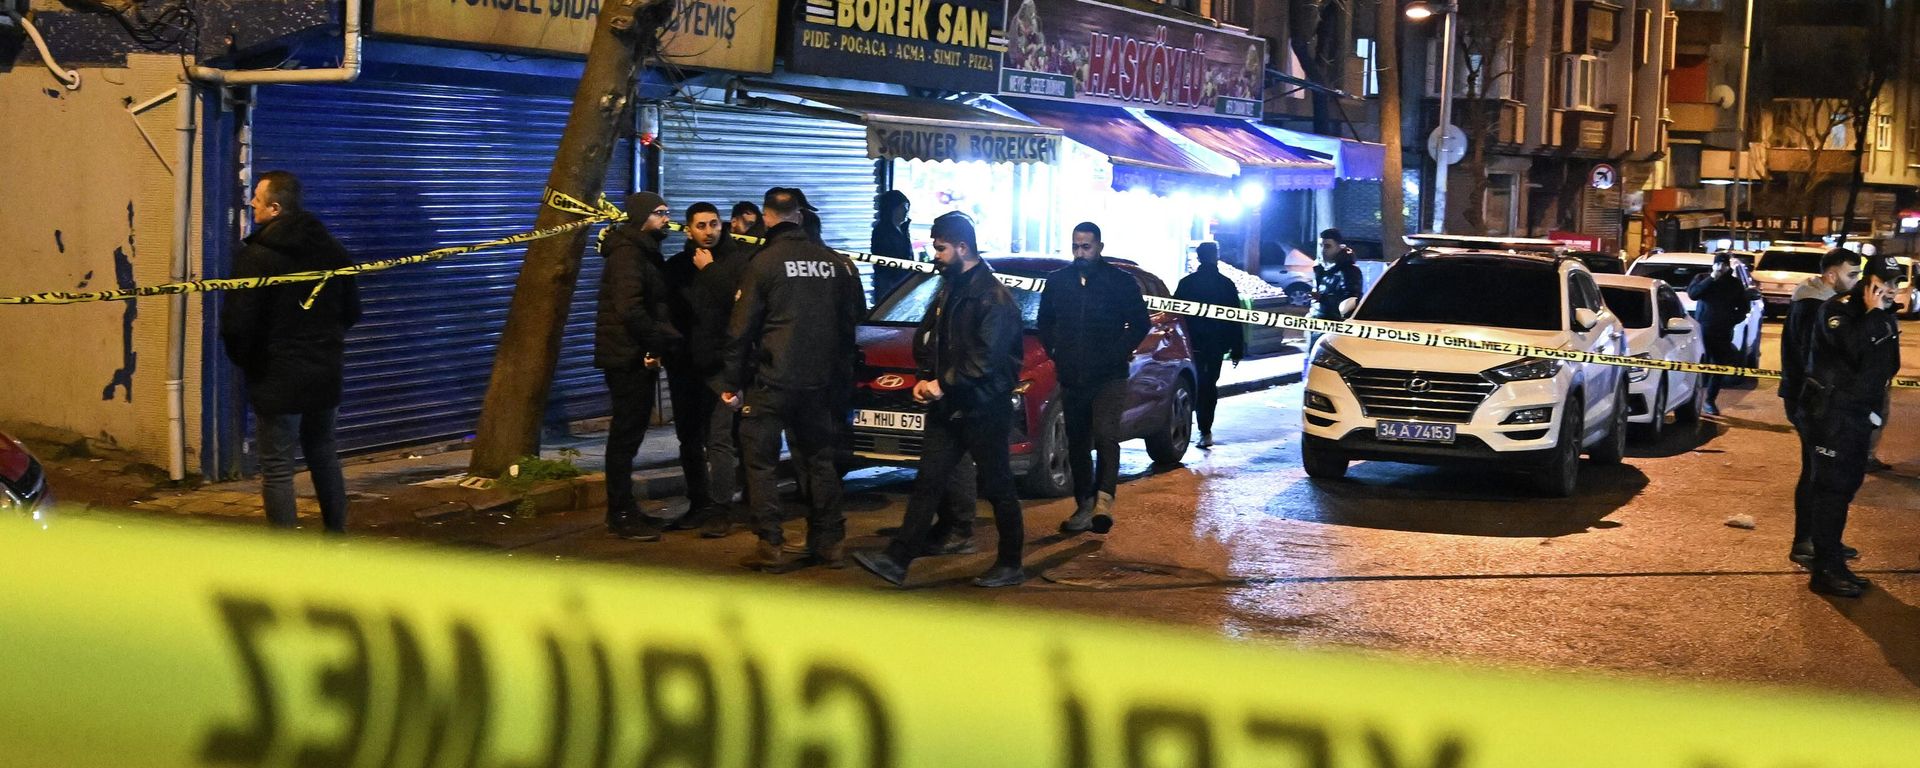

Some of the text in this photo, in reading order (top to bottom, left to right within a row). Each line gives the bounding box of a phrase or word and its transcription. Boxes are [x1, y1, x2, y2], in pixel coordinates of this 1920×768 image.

[936, 3, 989, 48] SAN
[802, 29, 831, 49] PIDE
[968, 53, 994, 71] PIZZA
[1085, 25, 1205, 108] HASKÖYLÜ
[875, 129, 957, 158] SARIYER
[784, 261, 836, 279] BEKÇİ
[1149, 298, 1192, 314] LMEZ
[873, 412, 895, 427] MHU
[901, 414, 922, 429] 679
[1380, 423, 1452, 439] 34 A 74153
